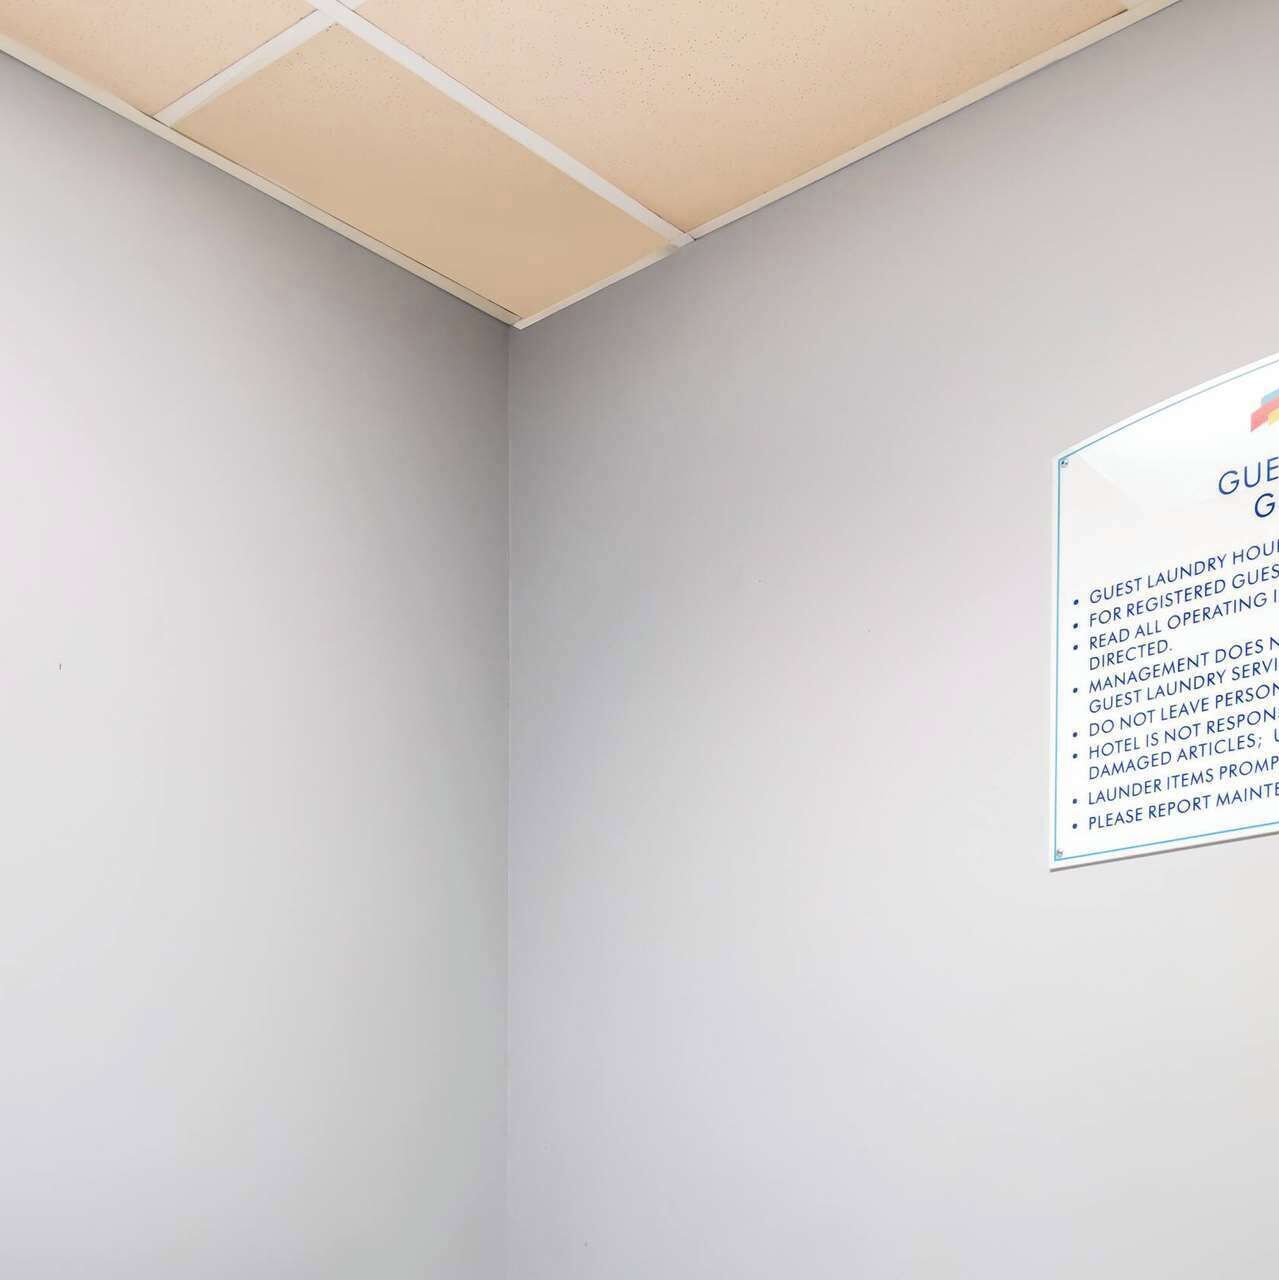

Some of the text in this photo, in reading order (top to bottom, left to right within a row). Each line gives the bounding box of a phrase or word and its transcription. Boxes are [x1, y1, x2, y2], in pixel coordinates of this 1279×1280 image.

[1089, 577, 1143, 604] GUEST
[1146, 553, 1228, 589] LAUNDRY
[1089, 606, 1122, 628] FOR
[1126, 578, 1227, 618] REGISTERED
[1089, 627, 1131, 651] READ
[1134, 619, 1163, 639] ALL
[1167, 591, 1268, 630] OPERATING
[1088, 651, 1211, 694] MANAGEMENT
[1215, 638, 1265, 664] DOES
[1089, 639, 1173, 671] DIRECTED.
[1088, 688, 1143, 714] GUEST
[1147, 669, 1227, 701] LAUNDRY
[1089, 719, 1115, 737] DO
[1119, 708, 1157, 731] NOT
[1160, 696, 1210, 721] LEAVE
[1088, 736, 1141, 760] HOTEL
[1145, 731, 1159, 748] IS
[1164, 722, 1202, 745] NOT
[1088, 751, 1172, 781] DAMAGED
[1176, 732, 1263, 763] ARTICLES;
[1087, 778, 1163, 806] LAUNDER
[1166, 767, 1215, 791] ITEMS
[1088, 807, 1143, 831] PLEASE
[1148, 794, 1212, 820] REPORT
